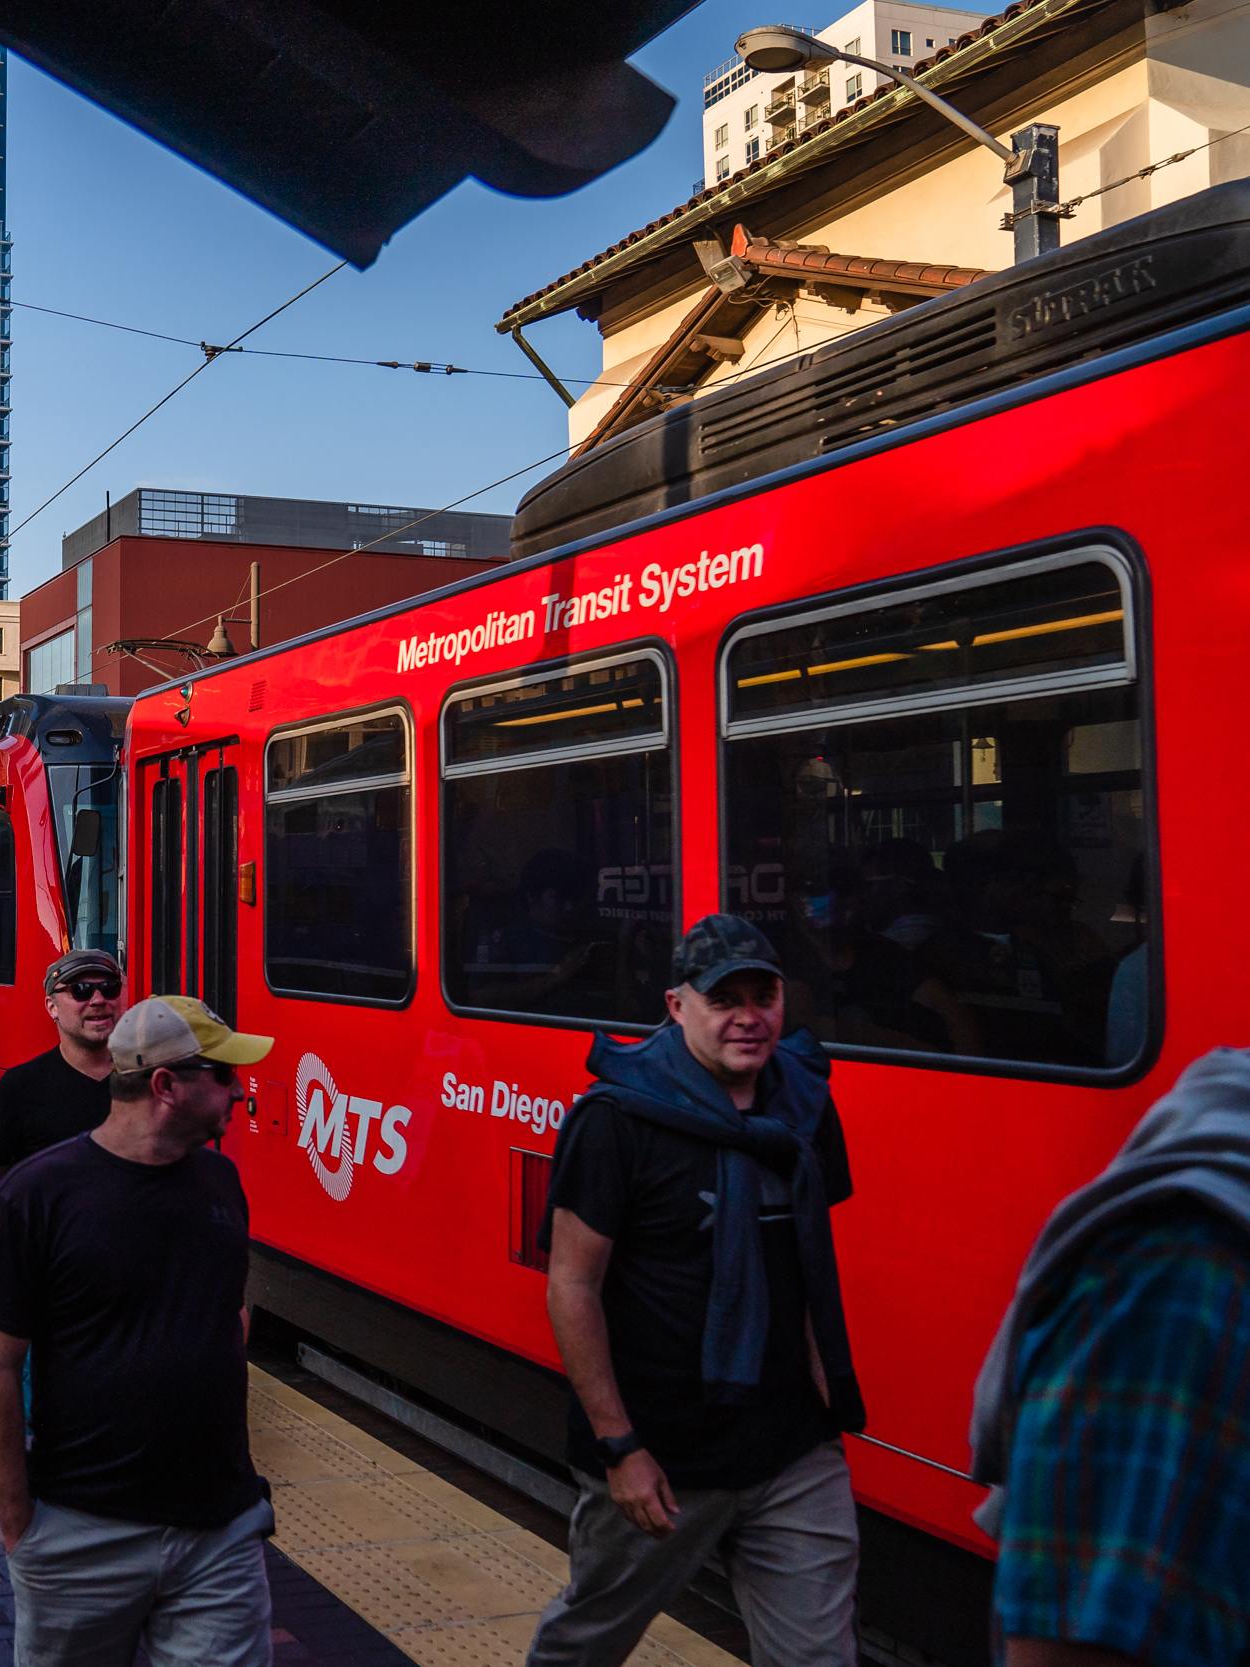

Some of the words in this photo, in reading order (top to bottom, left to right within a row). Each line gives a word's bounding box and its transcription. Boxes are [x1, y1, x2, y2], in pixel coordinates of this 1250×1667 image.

[397, 610, 535, 673] Metropolitan
[542, 573, 633, 633] Transit
[639, 543, 763, 612] System
[297, 1088, 412, 1175] MTS
[441, 1072, 485, 1114] San
[490, 1081, 565, 1134] Diego
